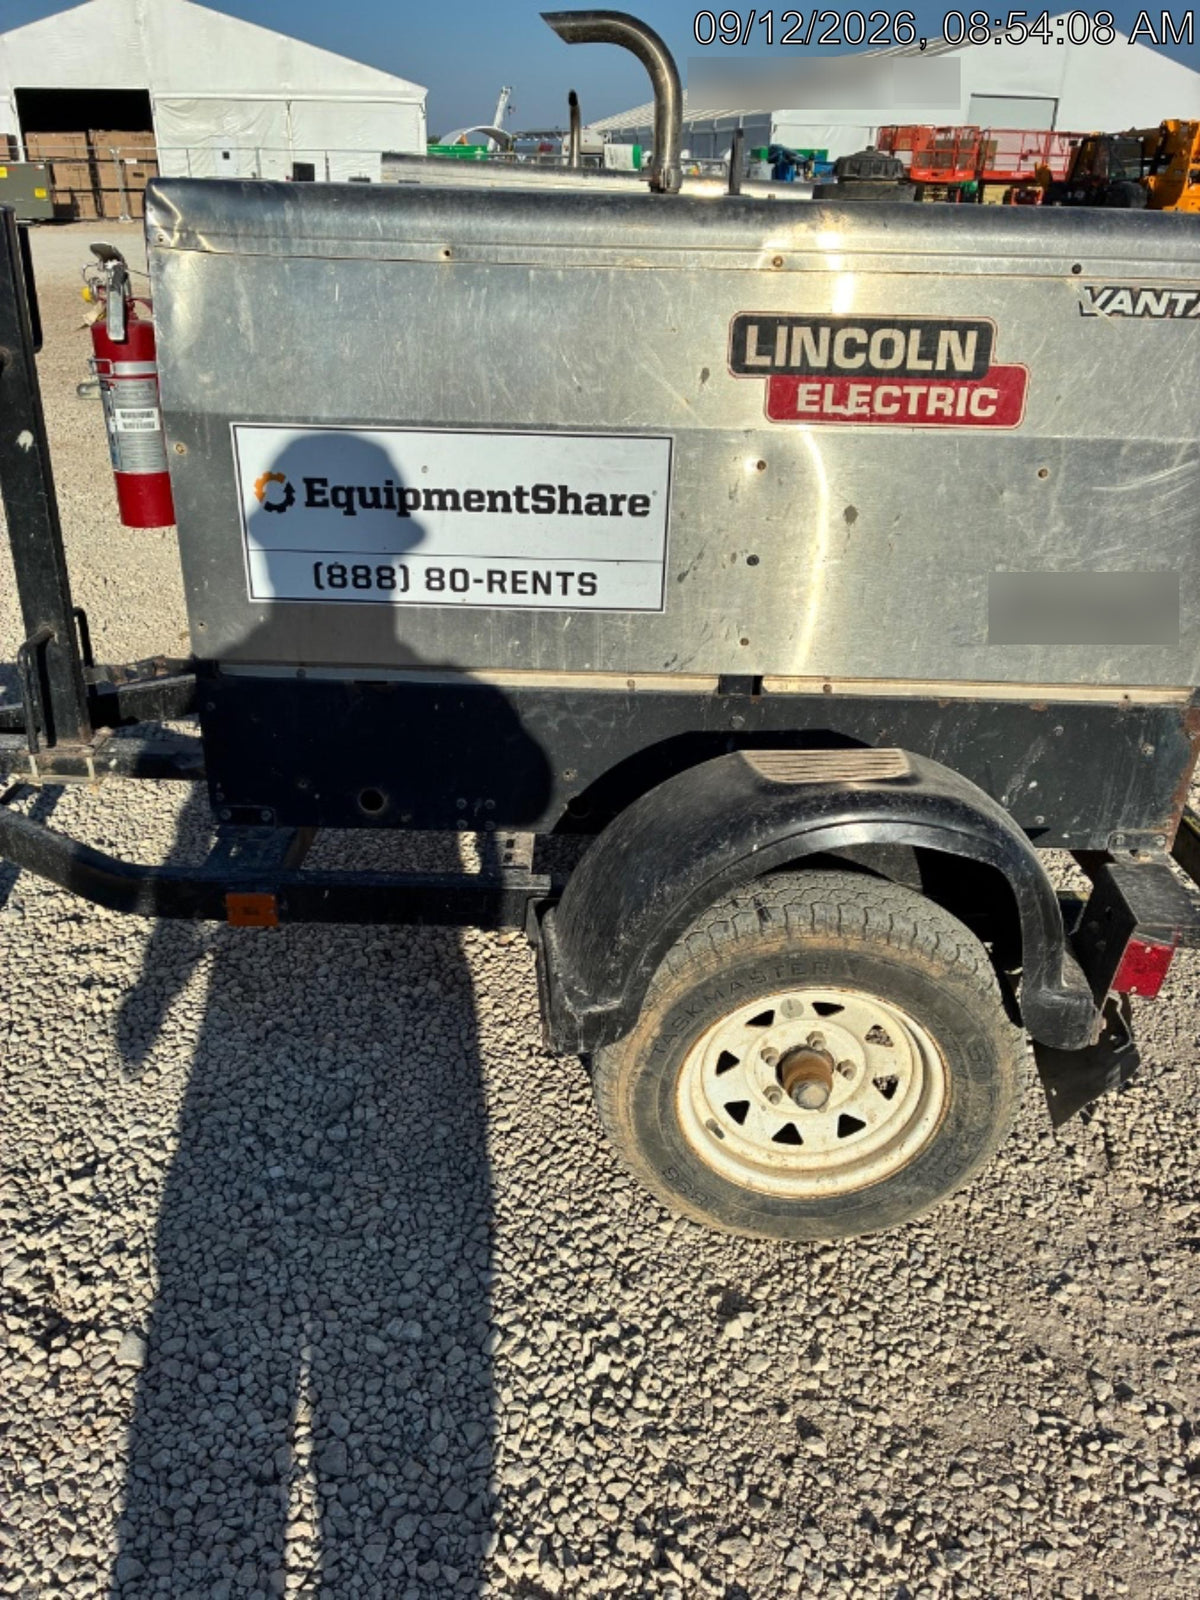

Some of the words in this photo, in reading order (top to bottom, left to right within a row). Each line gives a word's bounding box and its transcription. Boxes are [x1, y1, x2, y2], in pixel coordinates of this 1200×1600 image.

[745, 324, 978, 372] LINCOLN
[796, 382, 1000, 418] ELECTRIC
[302, 477, 651, 518] EquipmentShare
[313, 561, 410, 593] (888)
[424, 566, 599, 597] 80-RENTS
[652, 959, 832, 1056] TASKMASTER
